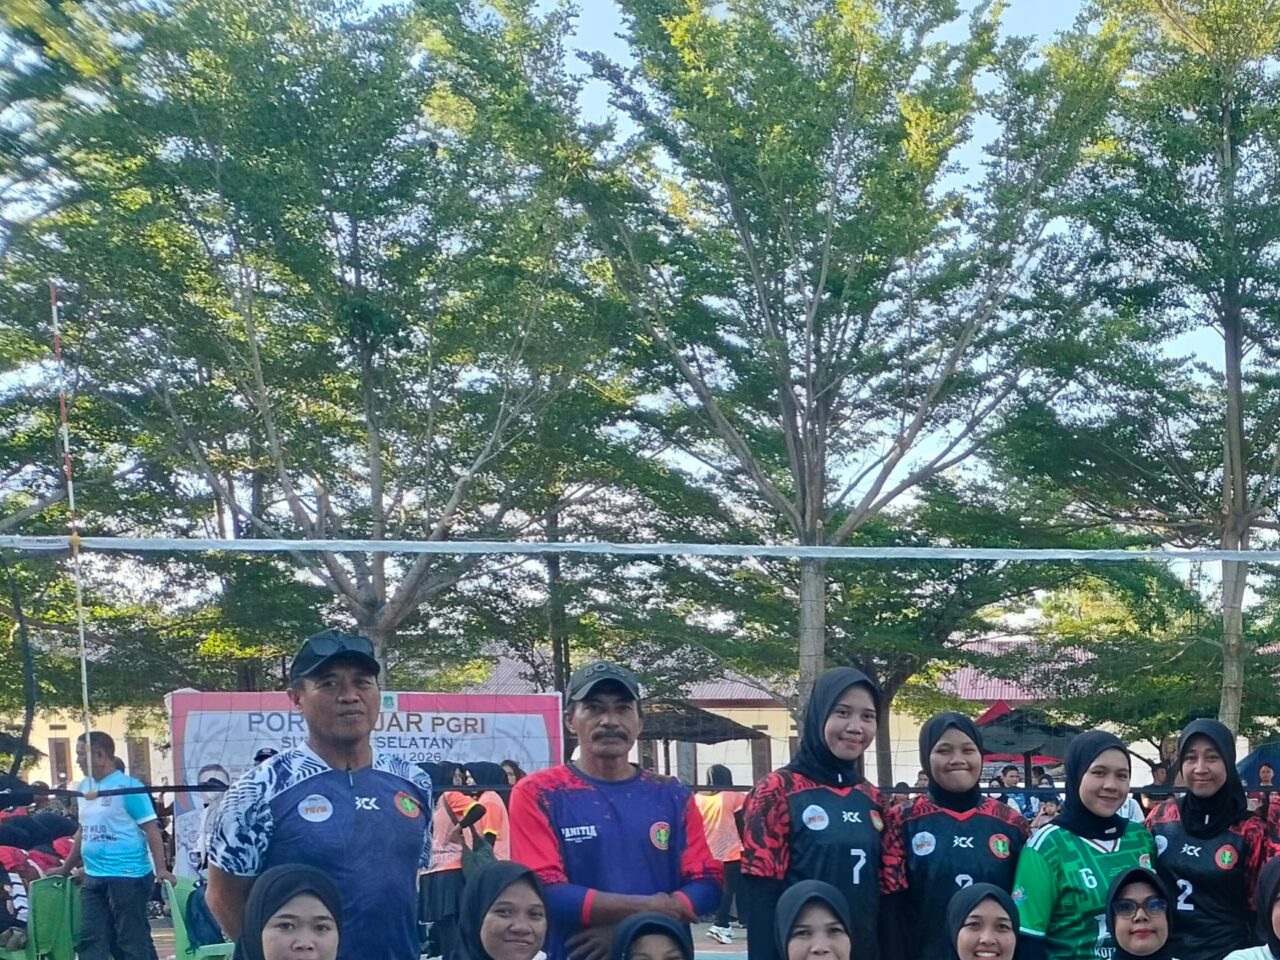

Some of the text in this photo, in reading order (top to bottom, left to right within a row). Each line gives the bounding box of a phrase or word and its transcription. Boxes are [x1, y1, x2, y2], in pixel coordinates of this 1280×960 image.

[431, 717, 485, 733] PGRI
[376, 736, 453, 749] SELATAN
[409, 752, 441, 762] 2026
[851, 849, 867, 884] 7
[1079, 868, 1098, 889] 6
[1176, 879, 1194, 911] 2
